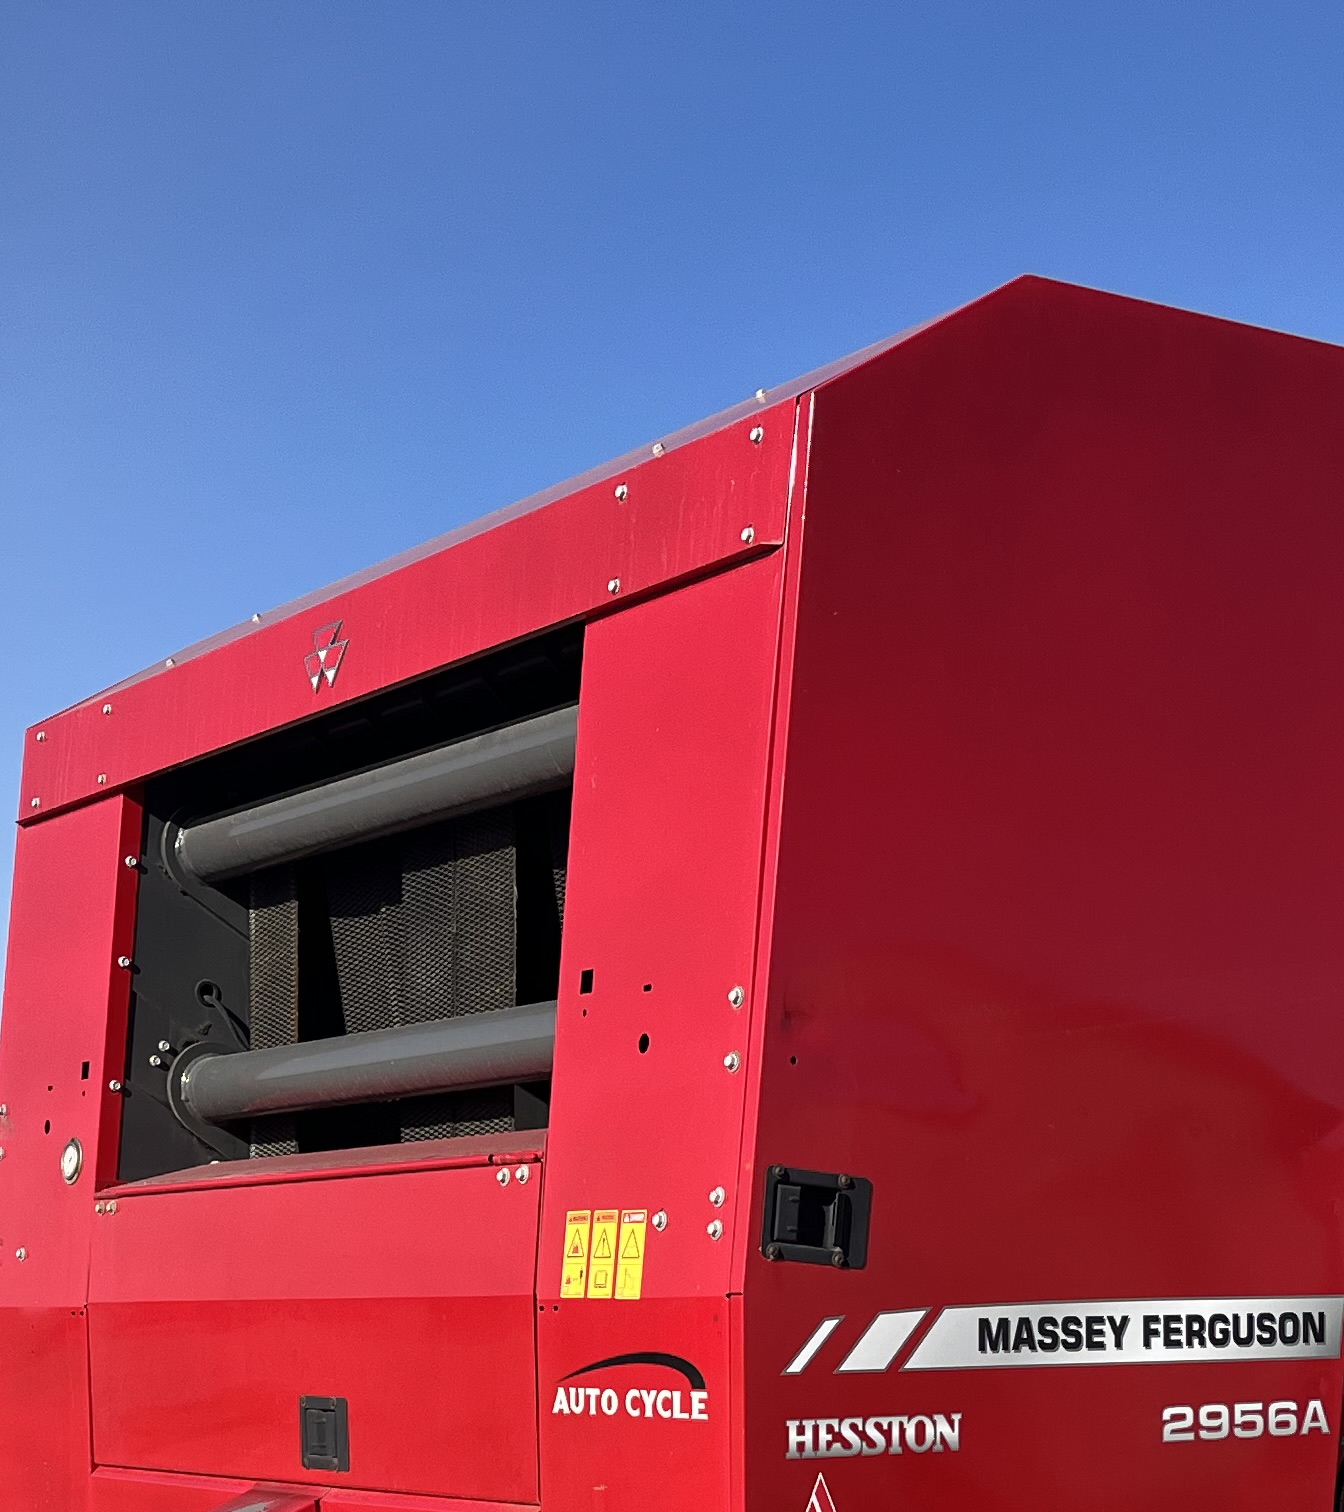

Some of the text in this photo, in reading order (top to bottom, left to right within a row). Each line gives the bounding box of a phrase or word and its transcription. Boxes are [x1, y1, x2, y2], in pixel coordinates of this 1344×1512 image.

[977, 1312, 1326, 1352] MASSEY FERGUSON
[552, 1386, 709, 1420] AUTO CYCLE
[1161, 1399, 1331, 1443] 2956A
[785, 1412, 962, 1459] HESSTON
